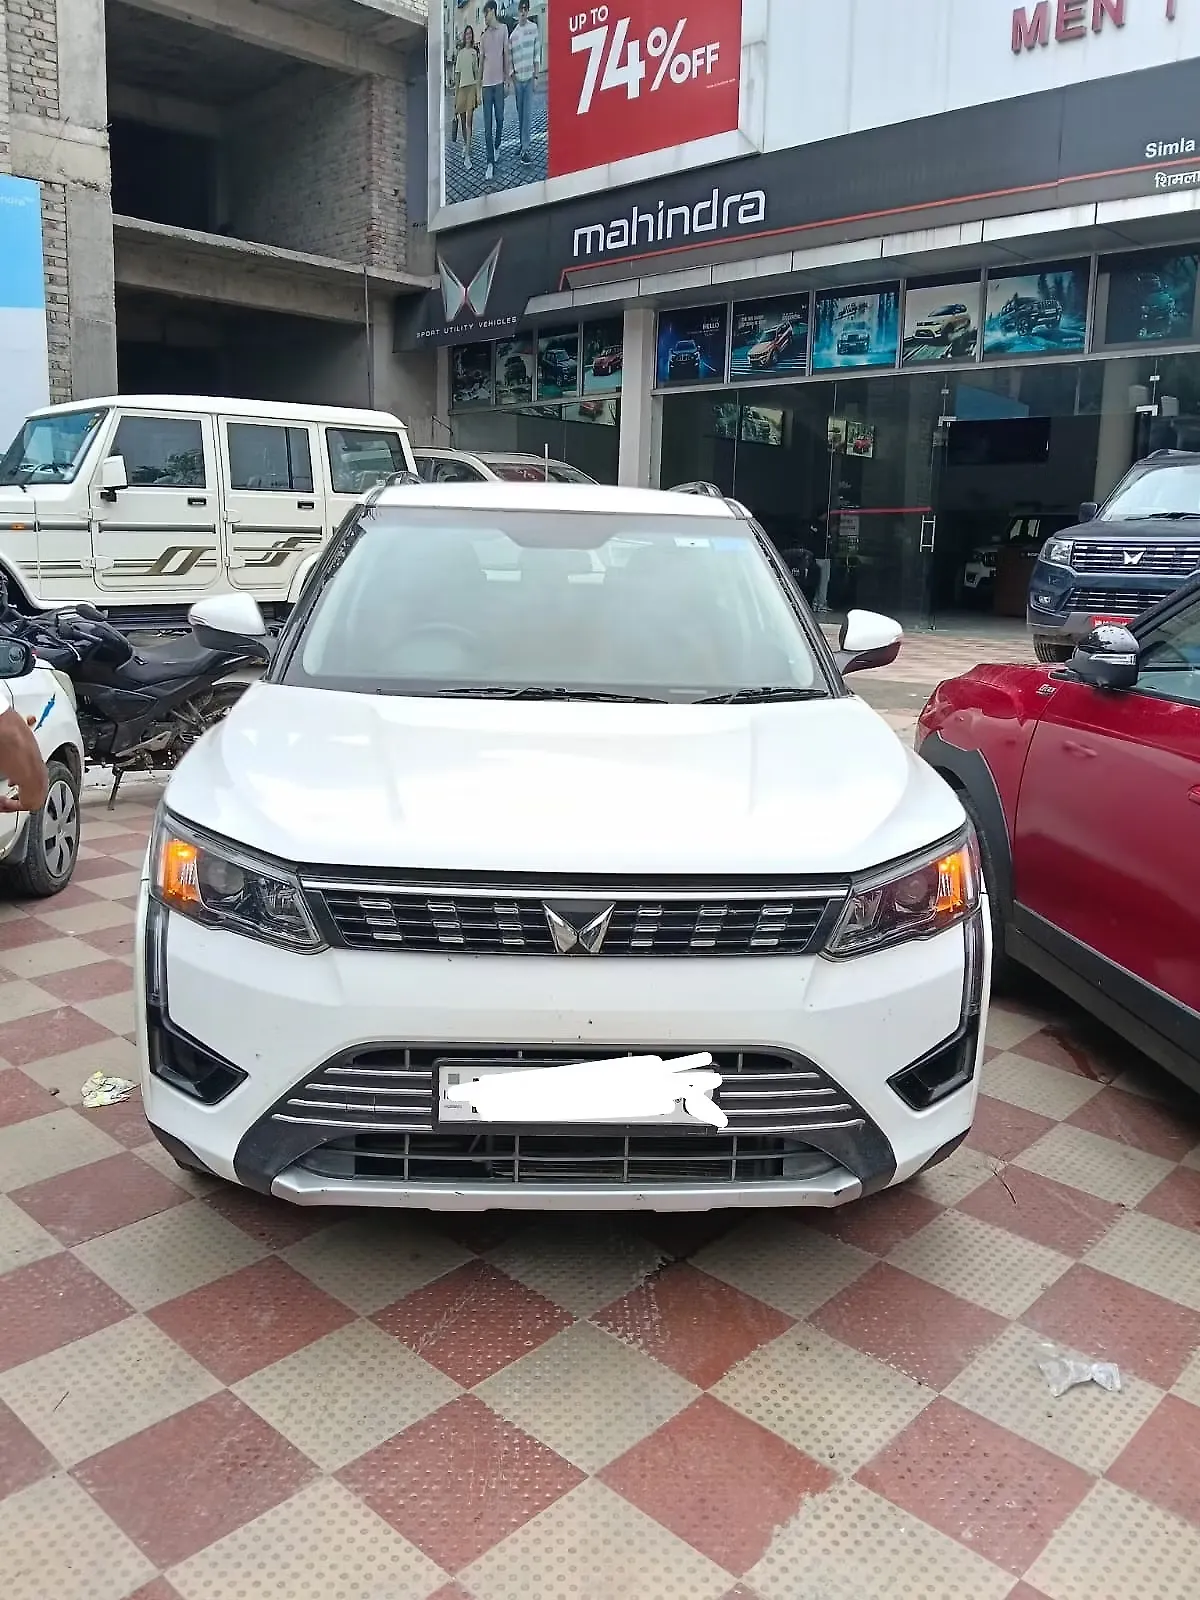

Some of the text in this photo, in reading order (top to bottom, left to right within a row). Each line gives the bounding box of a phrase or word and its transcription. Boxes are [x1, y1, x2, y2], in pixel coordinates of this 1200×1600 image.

[569, 5, 609, 33] UP TO
[1011, 0, 1125, 53] MEN
[1145, 137, 1196, 158] Simla
[1155, 171, 1200, 188] शिमला
[573, 187, 766, 257] mahindra
[416, 316, 517, 339] SPORT UTILITY VEHICLES
